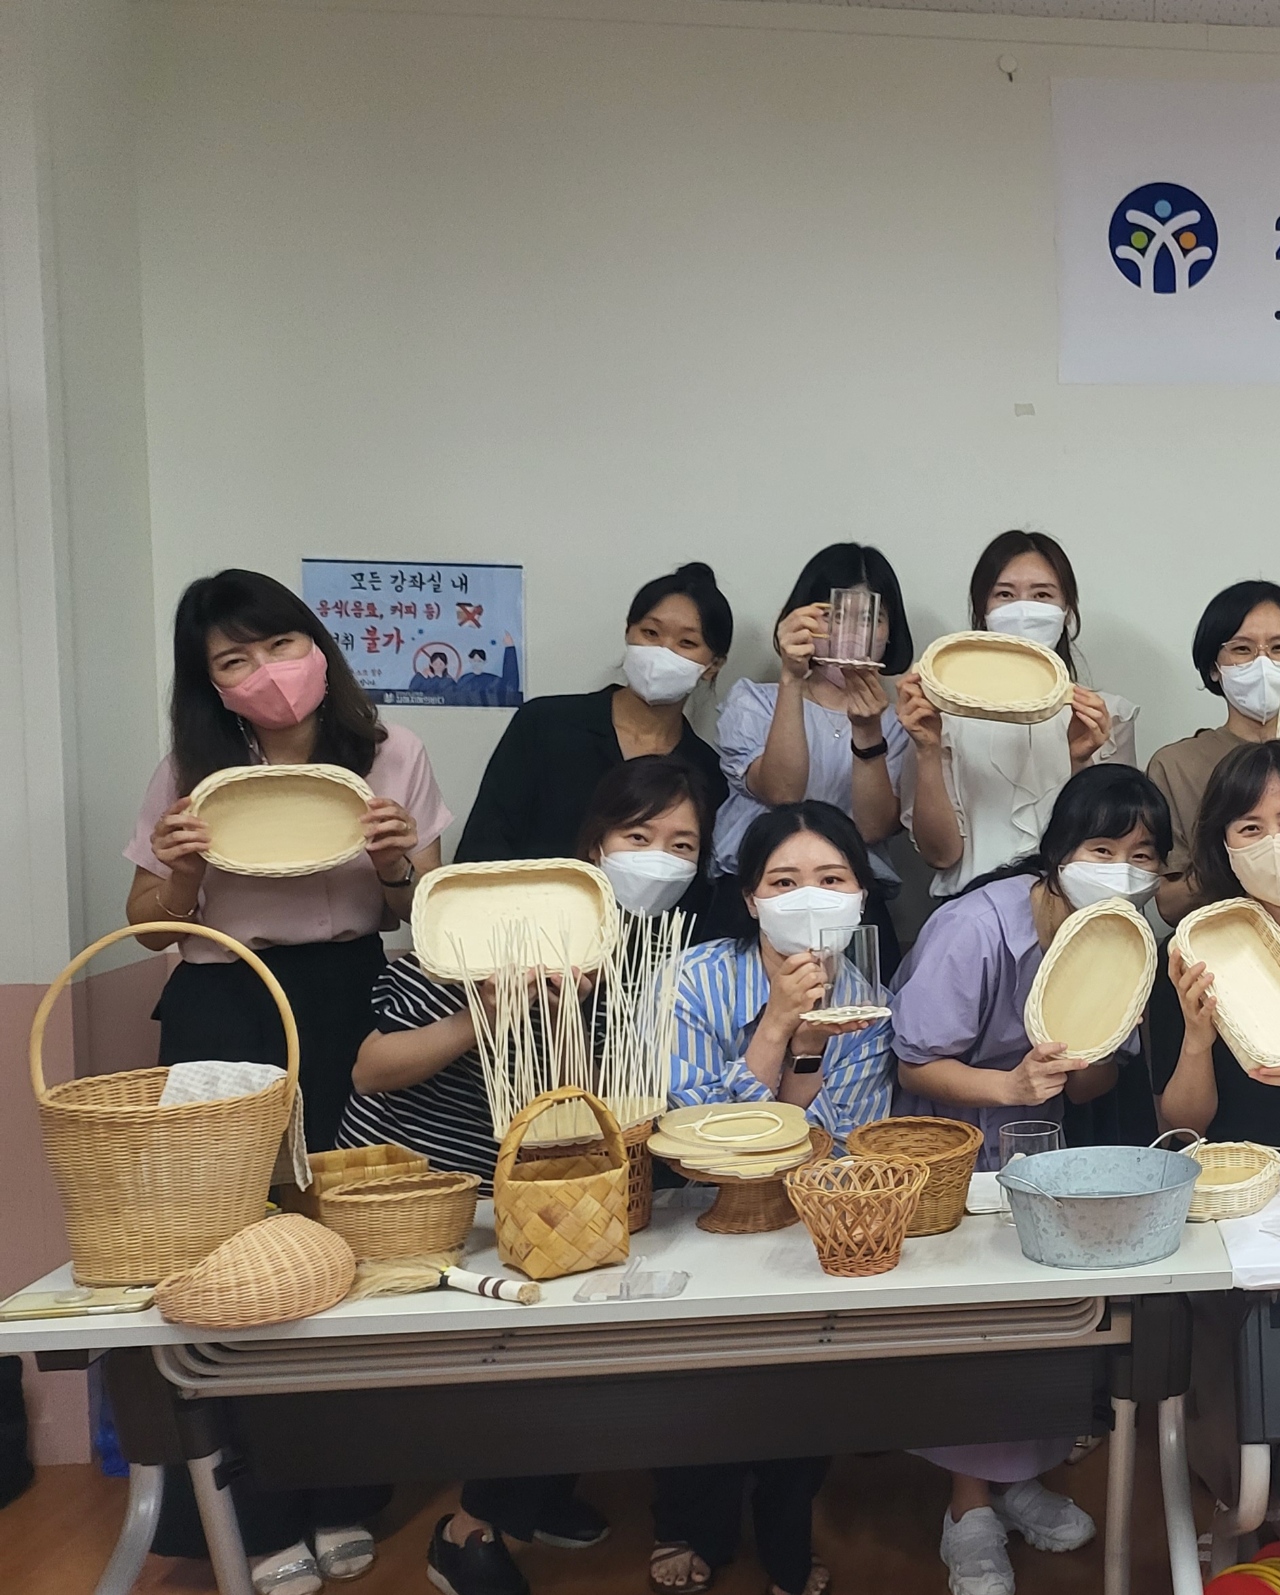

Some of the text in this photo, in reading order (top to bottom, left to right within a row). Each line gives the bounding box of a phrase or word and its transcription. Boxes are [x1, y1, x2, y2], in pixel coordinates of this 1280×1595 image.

[350, 569, 469, 594] 모든 강좌실 내
[390, 601, 417, 620] 커피
[423, 602, 441, 621] 등)
[360, 625, 404, 655] 불가
